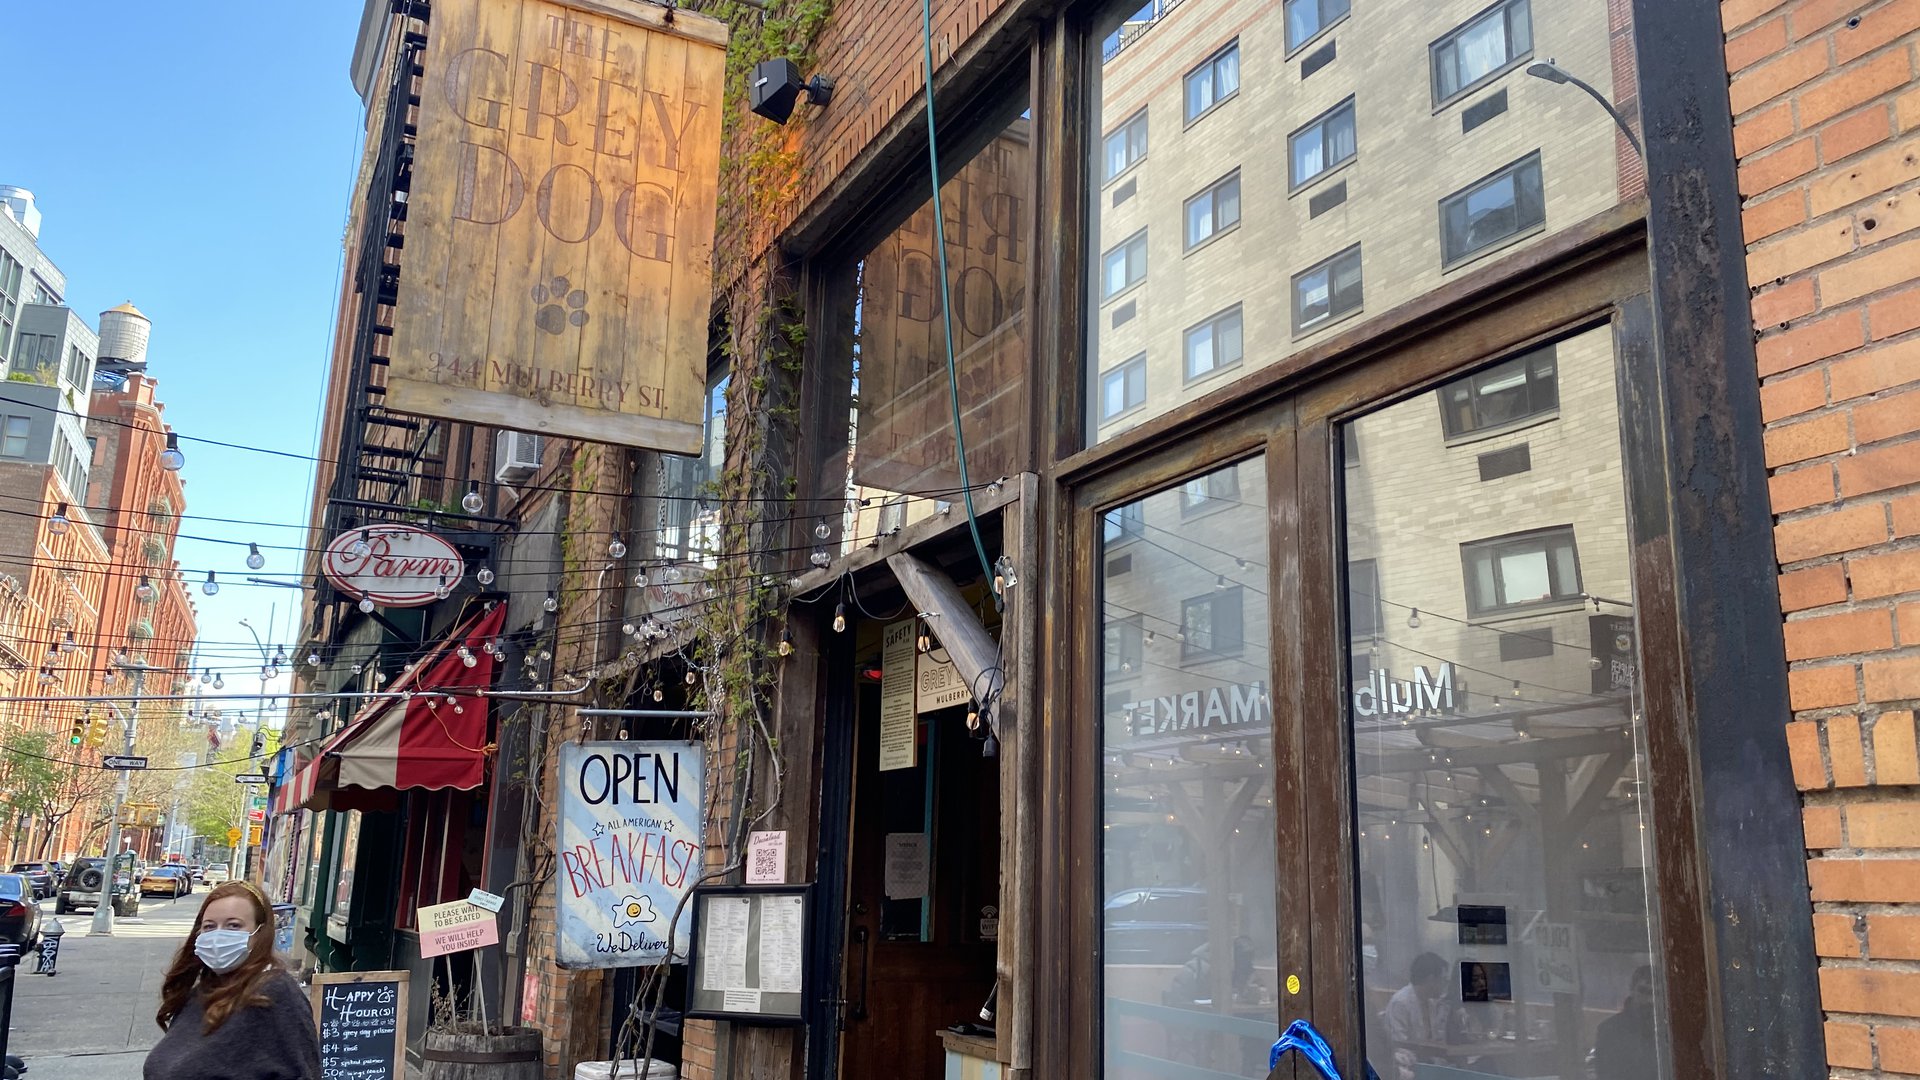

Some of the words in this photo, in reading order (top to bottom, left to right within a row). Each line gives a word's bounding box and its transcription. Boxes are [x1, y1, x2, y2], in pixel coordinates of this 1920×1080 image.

[547, 14, 624, 66] THE
[444, 47, 708, 175] GREY
[451, 140, 677, 264] DOG
[428, 352, 481, 380] 244
[490, 360, 630, 403] MULBERRY
[639, 385, 669, 411] ST.
[338, 534, 455, 578] Parm
[886, 624, 912, 648] SAFETY
[921, 663, 954, 692] GREY
[936, 690, 968, 704] MULBERRY
[108, 758, 122, 766] ONE
[580, 752, 679, 805] OPEN
[607, 819, 620, 830] ALL
[622, 818, 662, 829] AMERICAN
[562, 832, 700, 898] BREAKFAST
[434, 908, 459, 919] PLEASE
[461, 905, 478, 914] WAIT
[444, 918, 453, 926] BE
[455, 912, 480, 924] SEATED
[435, 937, 446, 945] WE
[448, 933, 465, 943] WILL
[467, 929, 484, 939] HELP
[441, 943, 456, 952] YOU
[457, 938, 479, 948] INSIDE
[596, 932, 618, 953] We
[618, 931, 669, 953] Deliver
[322, 1028, 340, 1039] $3
[322, 1043, 340, 1054] $4
[322, 1057, 340, 1067] $5
